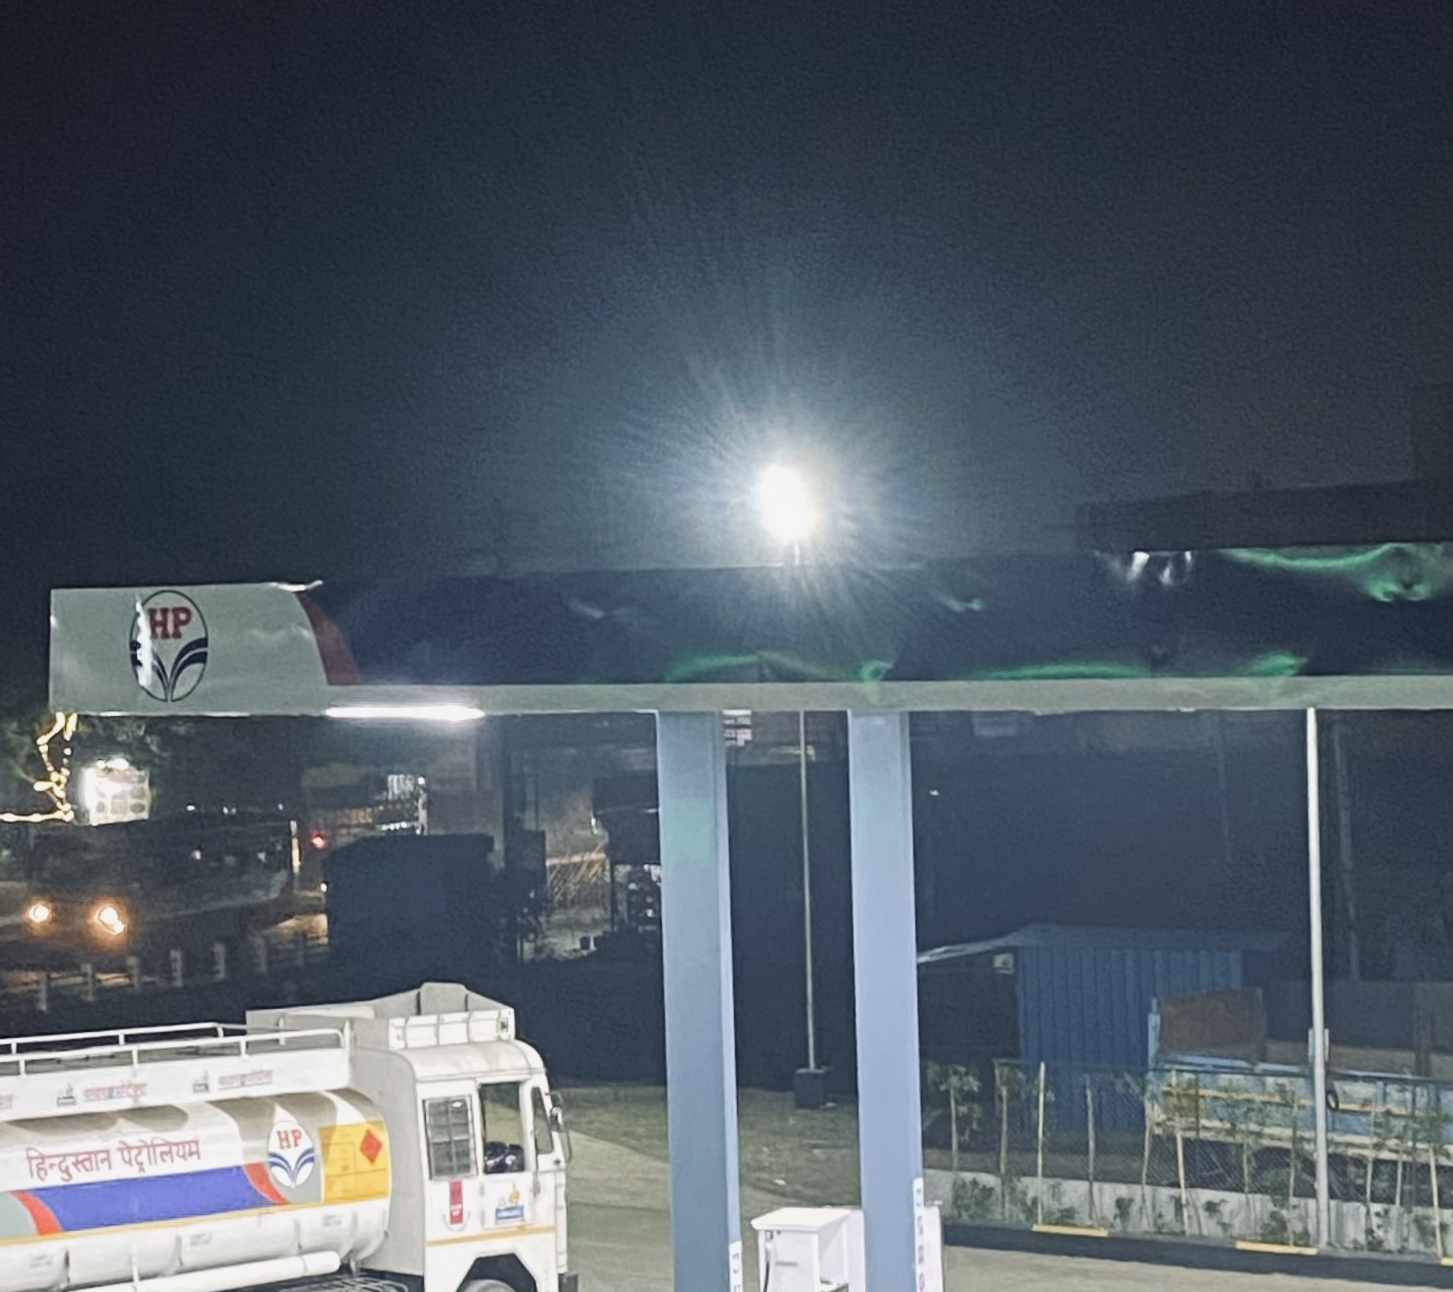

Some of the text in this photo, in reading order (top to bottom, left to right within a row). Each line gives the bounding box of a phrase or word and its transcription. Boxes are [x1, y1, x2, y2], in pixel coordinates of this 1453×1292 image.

[148, 606, 192, 639] HP
[277, 1129, 302, 1149] HP
[25, 1137, 202, 1181] हिन्दुस्तान पेट्रोलियम
